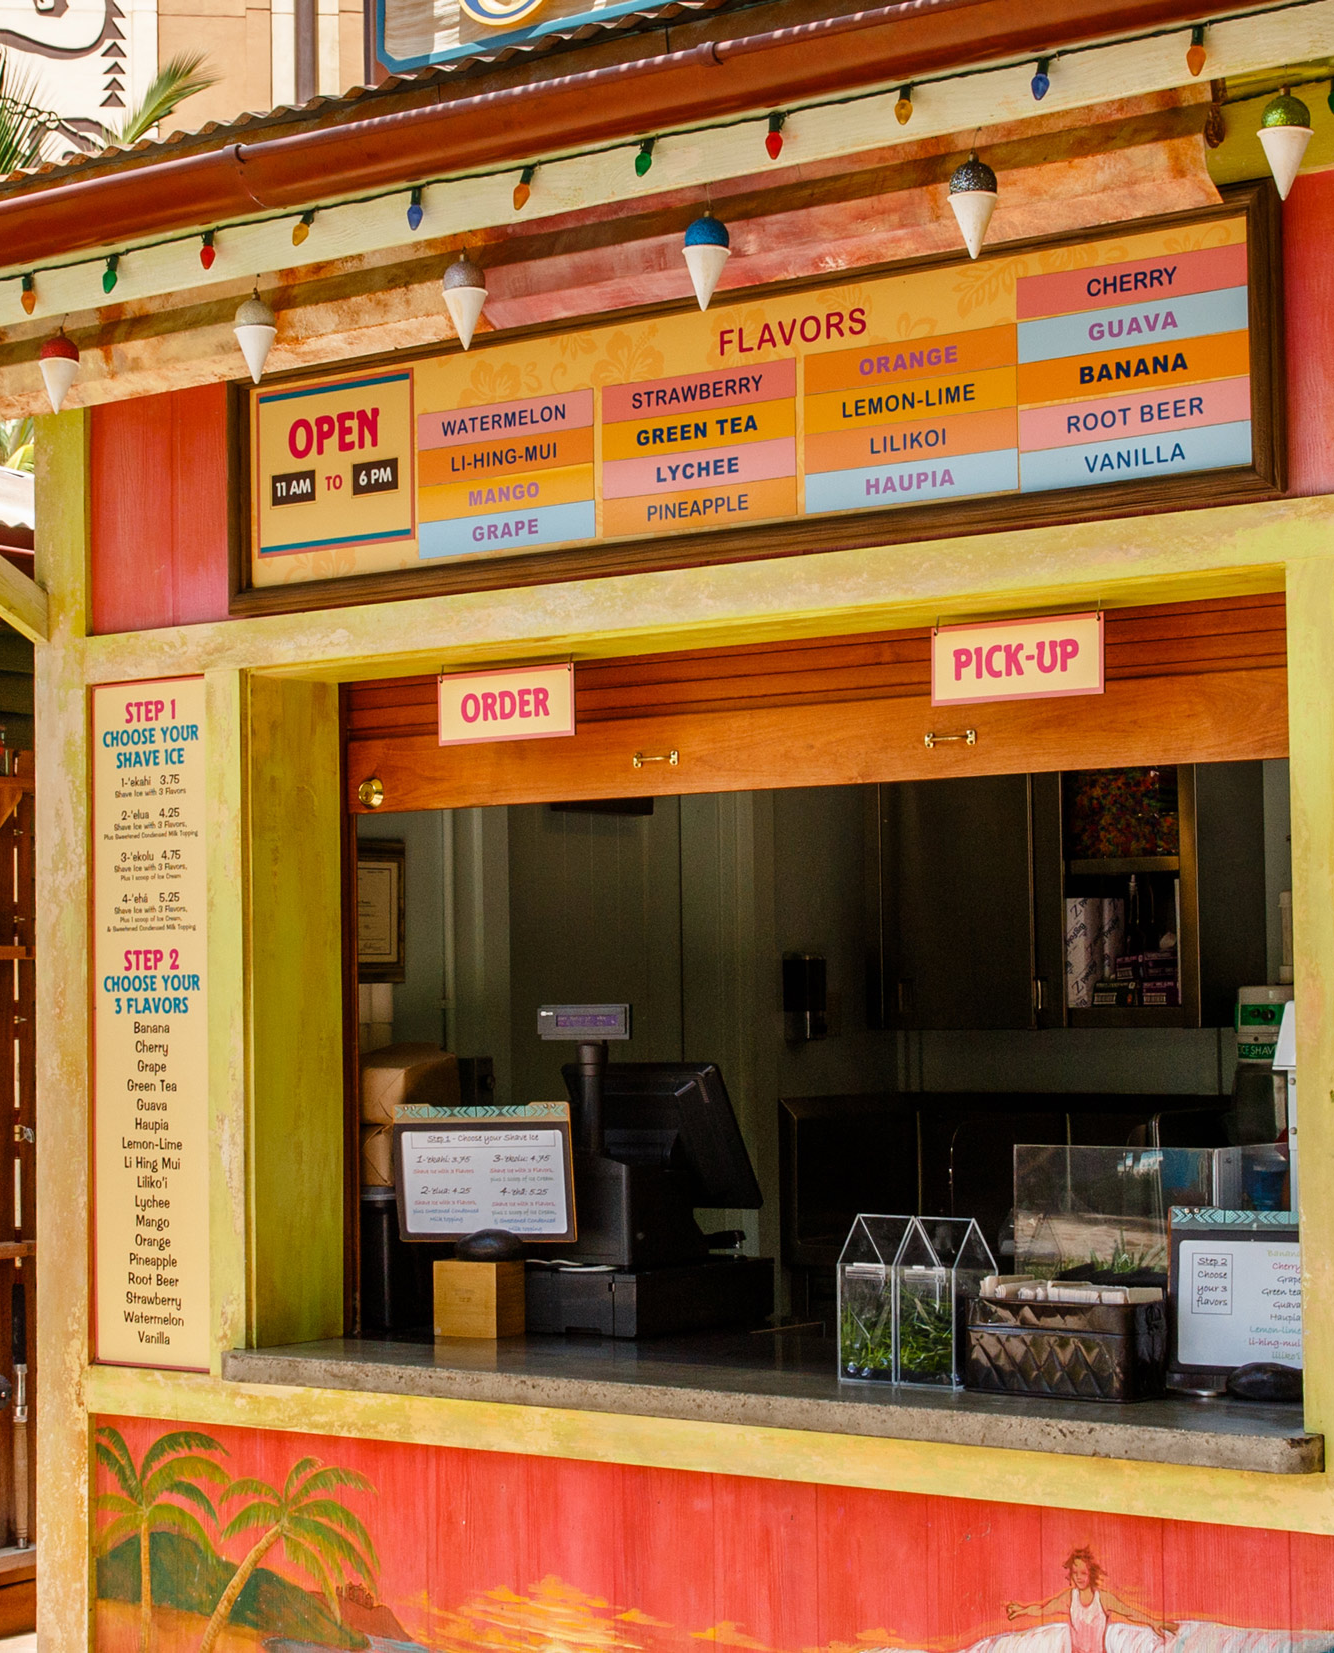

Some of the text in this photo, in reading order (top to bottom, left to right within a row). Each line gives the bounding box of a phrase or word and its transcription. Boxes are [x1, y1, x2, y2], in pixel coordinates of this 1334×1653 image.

[1085, 265, 1179, 298] CHERRY
[718, 307, 867, 357] FLAVORS
[1087, 310, 1179, 342] GUAVA
[858, 344, 959, 377] ORANGE
[1078, 351, 1189, 386] BANANA
[631, 374, 764, 410] STRAWBERRY
[841, 383, 977, 420] LEMON-LIME
[440, 404, 567, 438] WATERMELON
[1066, 396, 1204, 435] ROOT BEER
[287, 407, 380, 460] OPEN
[635, 414, 758, 448] GREEN TEA
[869, 428, 948, 456] LILIKOI
[450, 442, 558, 473] LI-HING-MUI
[1083, 442, 1186, 474] VANILLA
[654, 456, 740, 485] LYCHEE
[276, 467, 393, 498] 11 AM TO 6 PM
[864, 468, 956, 496] HAUPIA
[468, 482, 540, 508] MANGO
[646, 493, 750, 523] PINEAPPLE
[471, 518, 539, 543] GRAPE
[951, 637, 1080, 683] PICK-UP
[125, 699, 176, 723] STEP 1
[459, 685, 551, 725] ORDER
[103, 725, 198, 747] CHOOSE YOUR
[116, 748, 185, 769] SHAVE ICE
[160, 774, 180, 785] 3.75
[166, 787, 186, 795] Flavors
[159, 808, 180, 818] 4.25
[161, 850, 181, 860] 4.75
[114, 865, 131, 873] Shave
[159, 892, 180, 902] 5.25
[123, 948, 180, 971] STEP 2
[103, 974, 200, 993] CHOOSE YOUR
[114, 997, 189, 1014] 3 FLAVORS
[133, 1021, 170, 1035] Banana
[135, 1041, 169, 1057] Cherry
[1250, 1046, 1275, 1055] SHAV
[137, 1060, 167, 1075] Grape
[126, 1079, 178, 1094] Green Tea
[136, 1098, 168, 1112] Guava
[135, 1118, 169, 1133] Haupia
[121, 1137, 183, 1151] Lemon-Lime
[427, 1136, 444, 1144] Step
[457, 1134, 482, 1142] Choose
[484, 1135, 503, 1145] your
[124, 1156, 181, 1172] Li Hing Mui
[135, 1195, 170, 1210] Lychee
[135, 1215, 170, 1231] Mango
[135, 1234, 171, 1249] Orange
[129, 1253, 178, 1270] Pineapple
[1197, 1257, 1227, 1267] Step 2
[127, 1272, 179, 1288] Root Beer
[1198, 1270, 1228, 1279] Choose
[1197, 1285, 1219, 1295] your
[1262, 1288, 1287, 1296] Green
[125, 1292, 182, 1309] Strawberry
[1196, 1296, 1228, 1307] flavors
[1273, 1301, 1301, 1309] Guava
[123, 1311, 185, 1327] Watermelon
[1270, 1313, 1301, 1323] Haupia
[137, 1331, 170, 1346] Vanilla
